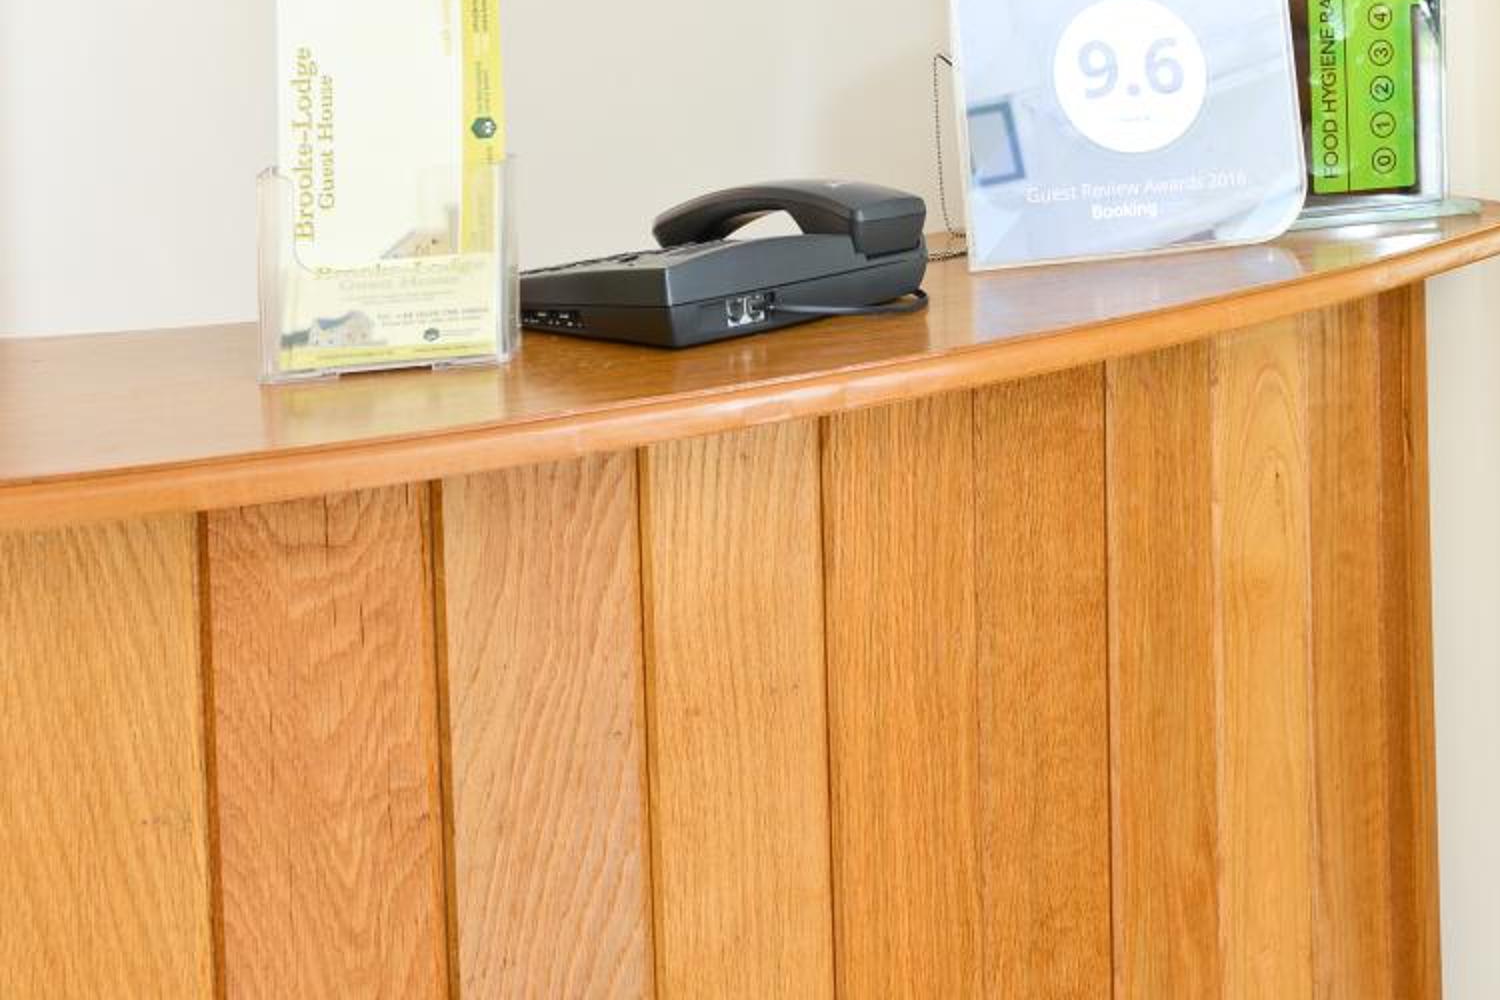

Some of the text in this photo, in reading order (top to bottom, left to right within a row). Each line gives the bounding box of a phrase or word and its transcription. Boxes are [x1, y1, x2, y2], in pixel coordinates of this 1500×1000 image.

[1077, 36, 1185, 99] 9.6
[1319, 27, 1337, 112] HYGIENE
[291, 47, 318, 242] Brooke-Lodge
[317, 74, 335, 211] Guest House
[1322, 119, 1339, 179] FOOD
[1024, 184, 1077, 204] Guest
